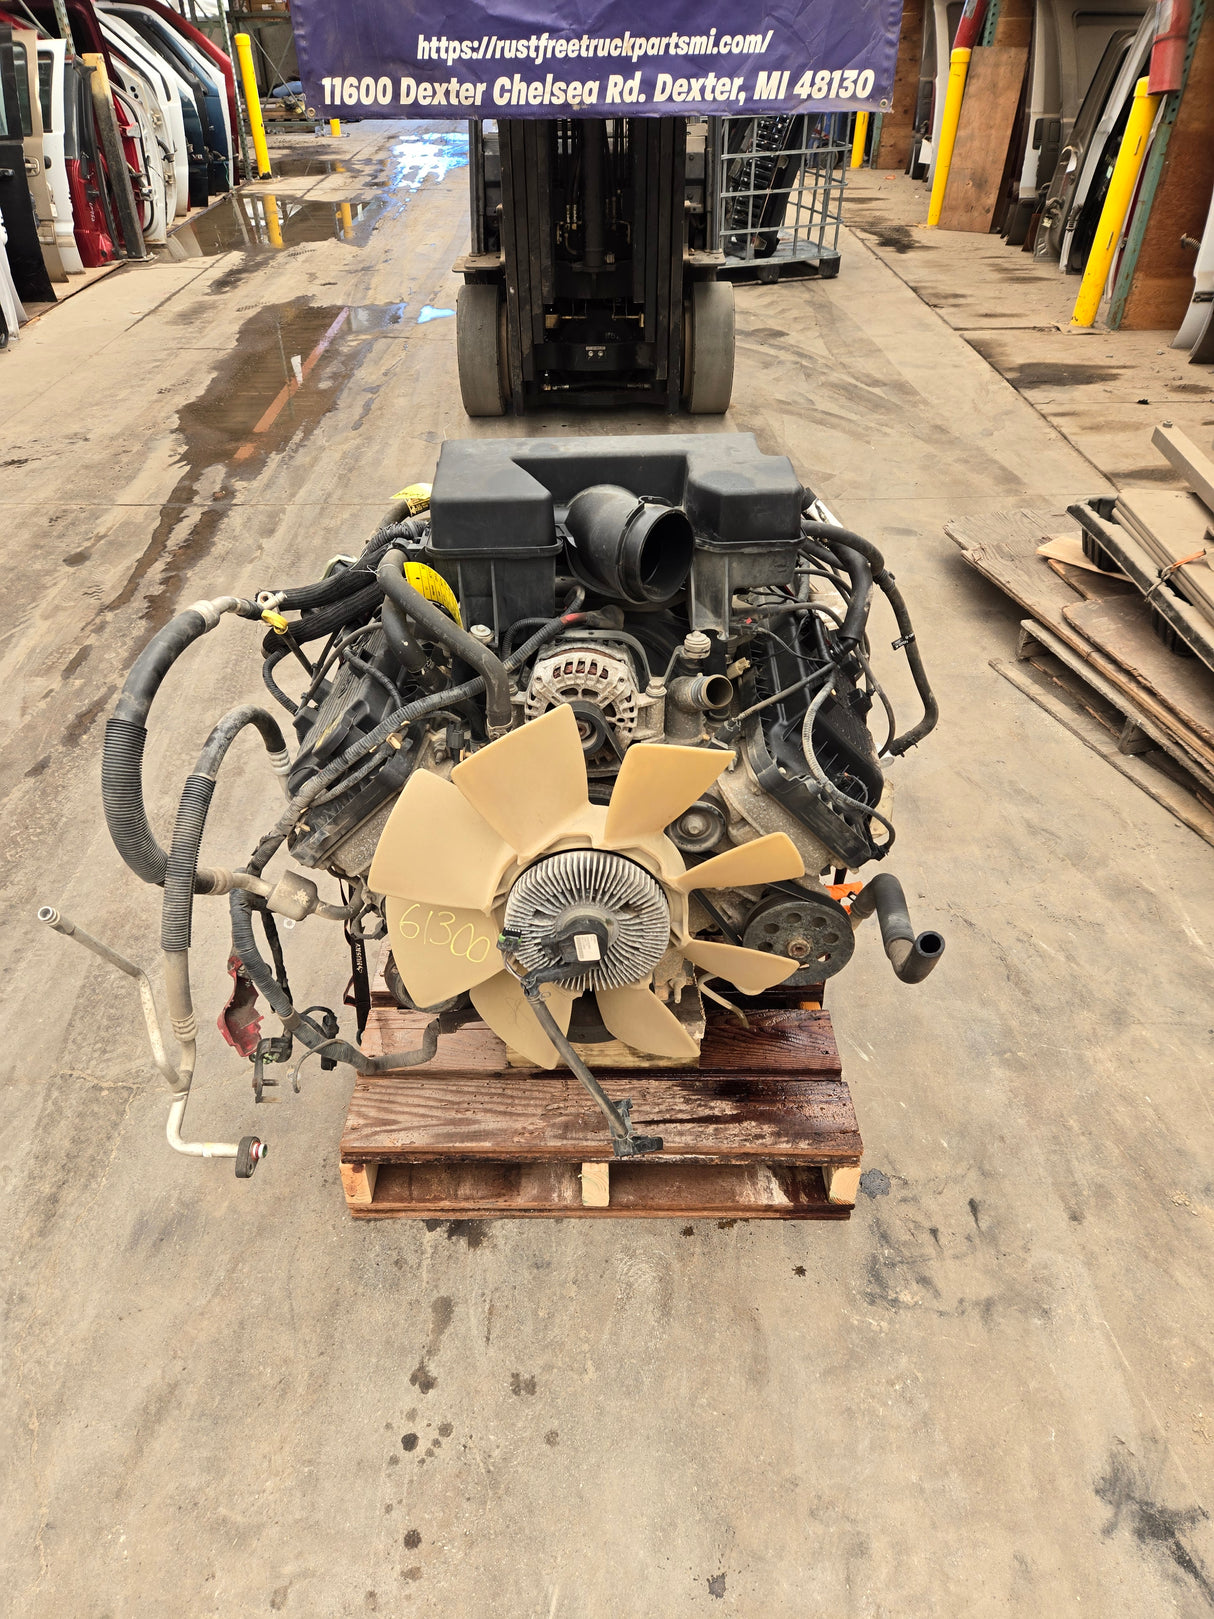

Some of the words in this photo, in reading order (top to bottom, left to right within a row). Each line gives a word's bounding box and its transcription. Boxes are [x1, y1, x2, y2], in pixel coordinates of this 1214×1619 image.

[416, 28, 774, 65] https://rustfreetruckpartsmi.com/
[322, 76, 393, 105] 11600
[400, 77, 487, 106] Dexter
[493, 74, 601, 105] Chelsea
[605, 71, 645, 104] Rd.
[653, 71, 746, 104] Dexter,
[753, 70, 790, 100] MI
[794, 69, 876, 99] 48130
[399, 903, 491, 963] 61300
